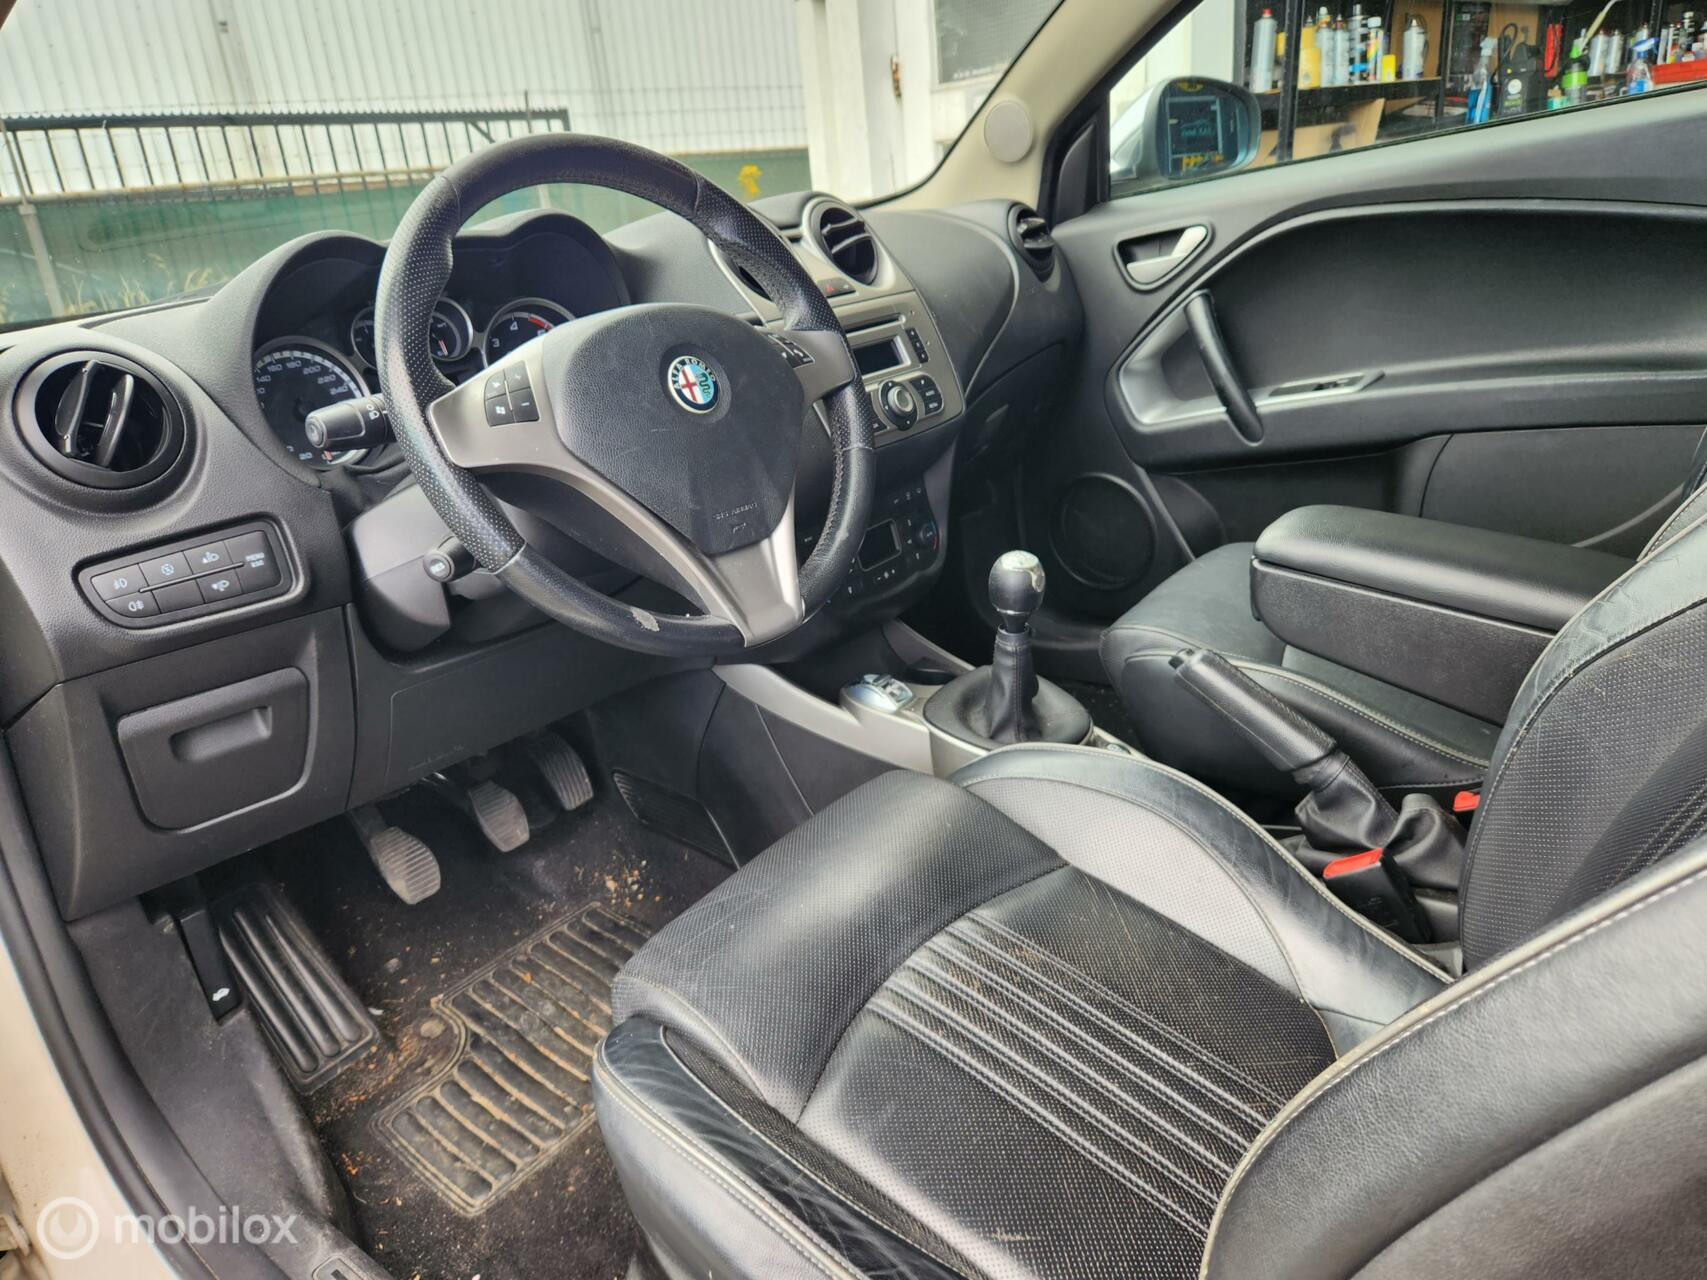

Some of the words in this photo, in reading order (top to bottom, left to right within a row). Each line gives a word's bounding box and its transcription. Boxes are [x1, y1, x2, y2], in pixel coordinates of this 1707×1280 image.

[510, 321, 519, 331] 4
[491, 338, 500, 348] 3
[672, 363, 683, 389] ALFA
